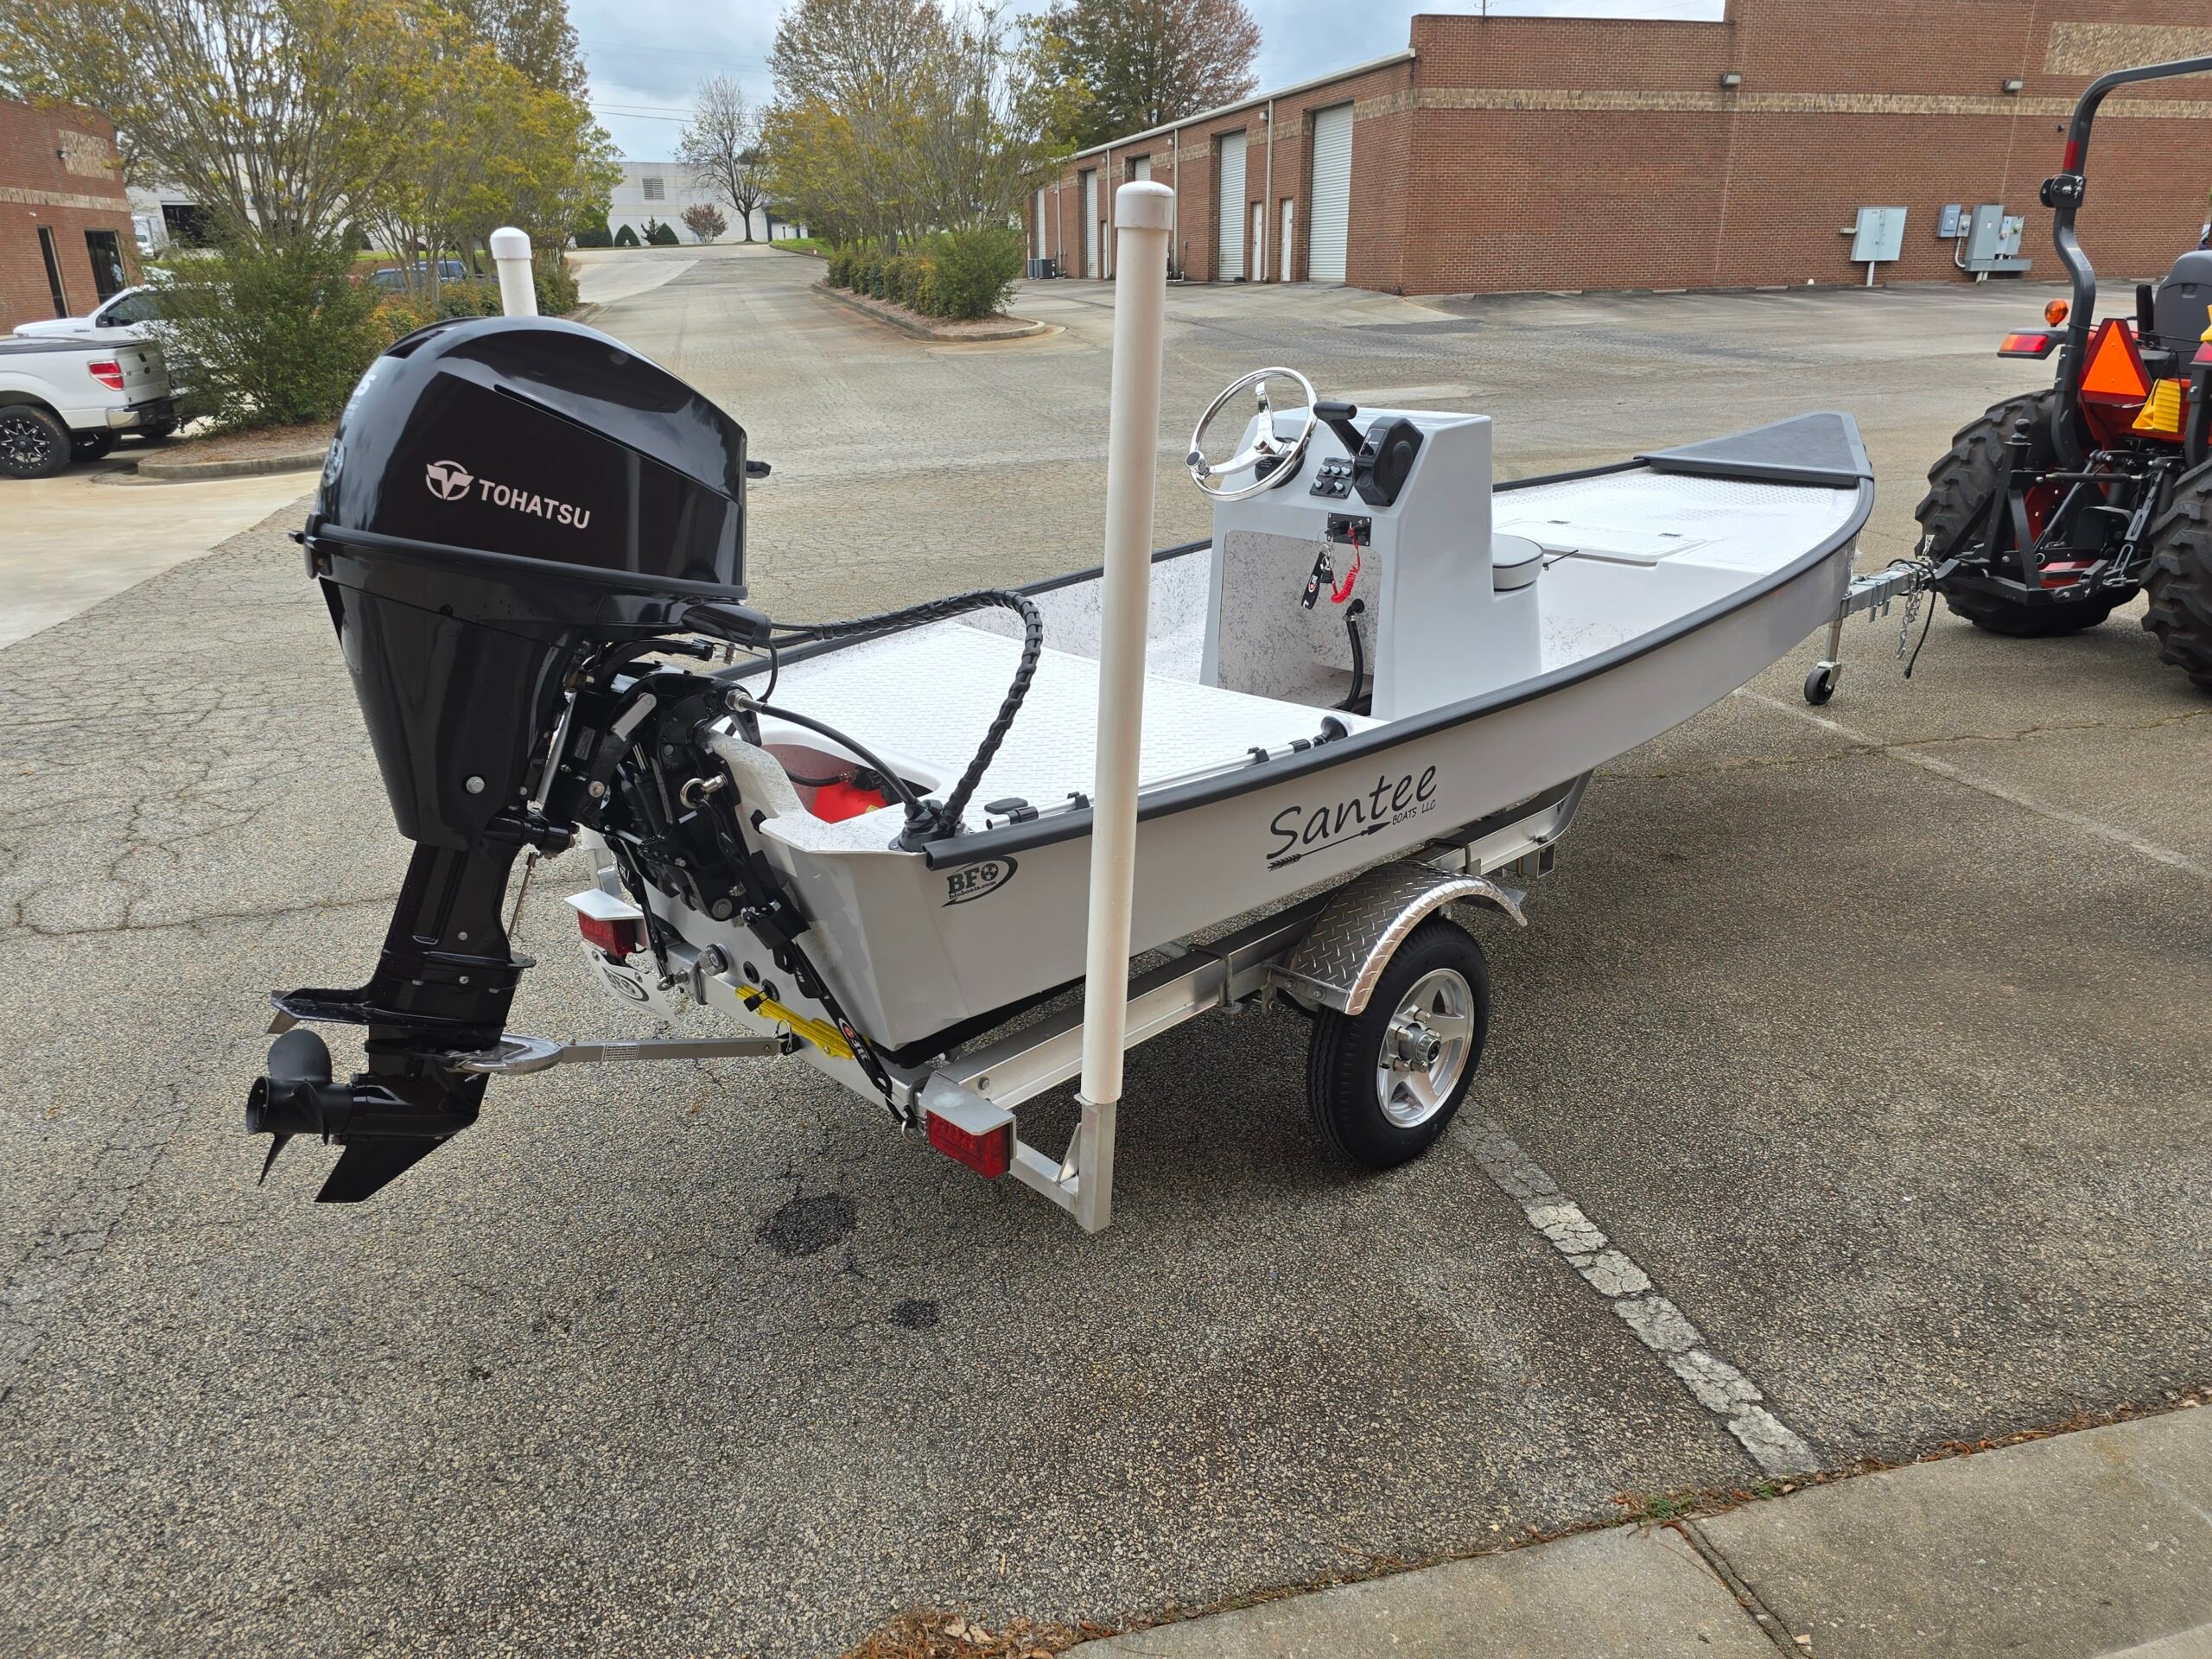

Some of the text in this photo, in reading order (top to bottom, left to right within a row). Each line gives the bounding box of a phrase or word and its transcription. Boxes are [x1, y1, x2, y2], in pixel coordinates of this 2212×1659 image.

[479, 479, 590, 529] TOHATSU
[1266, 766, 1438, 860] Santee
[1392, 799, 1436, 825] BOATS LLC
[949, 880, 996, 899] bfoboats.com
